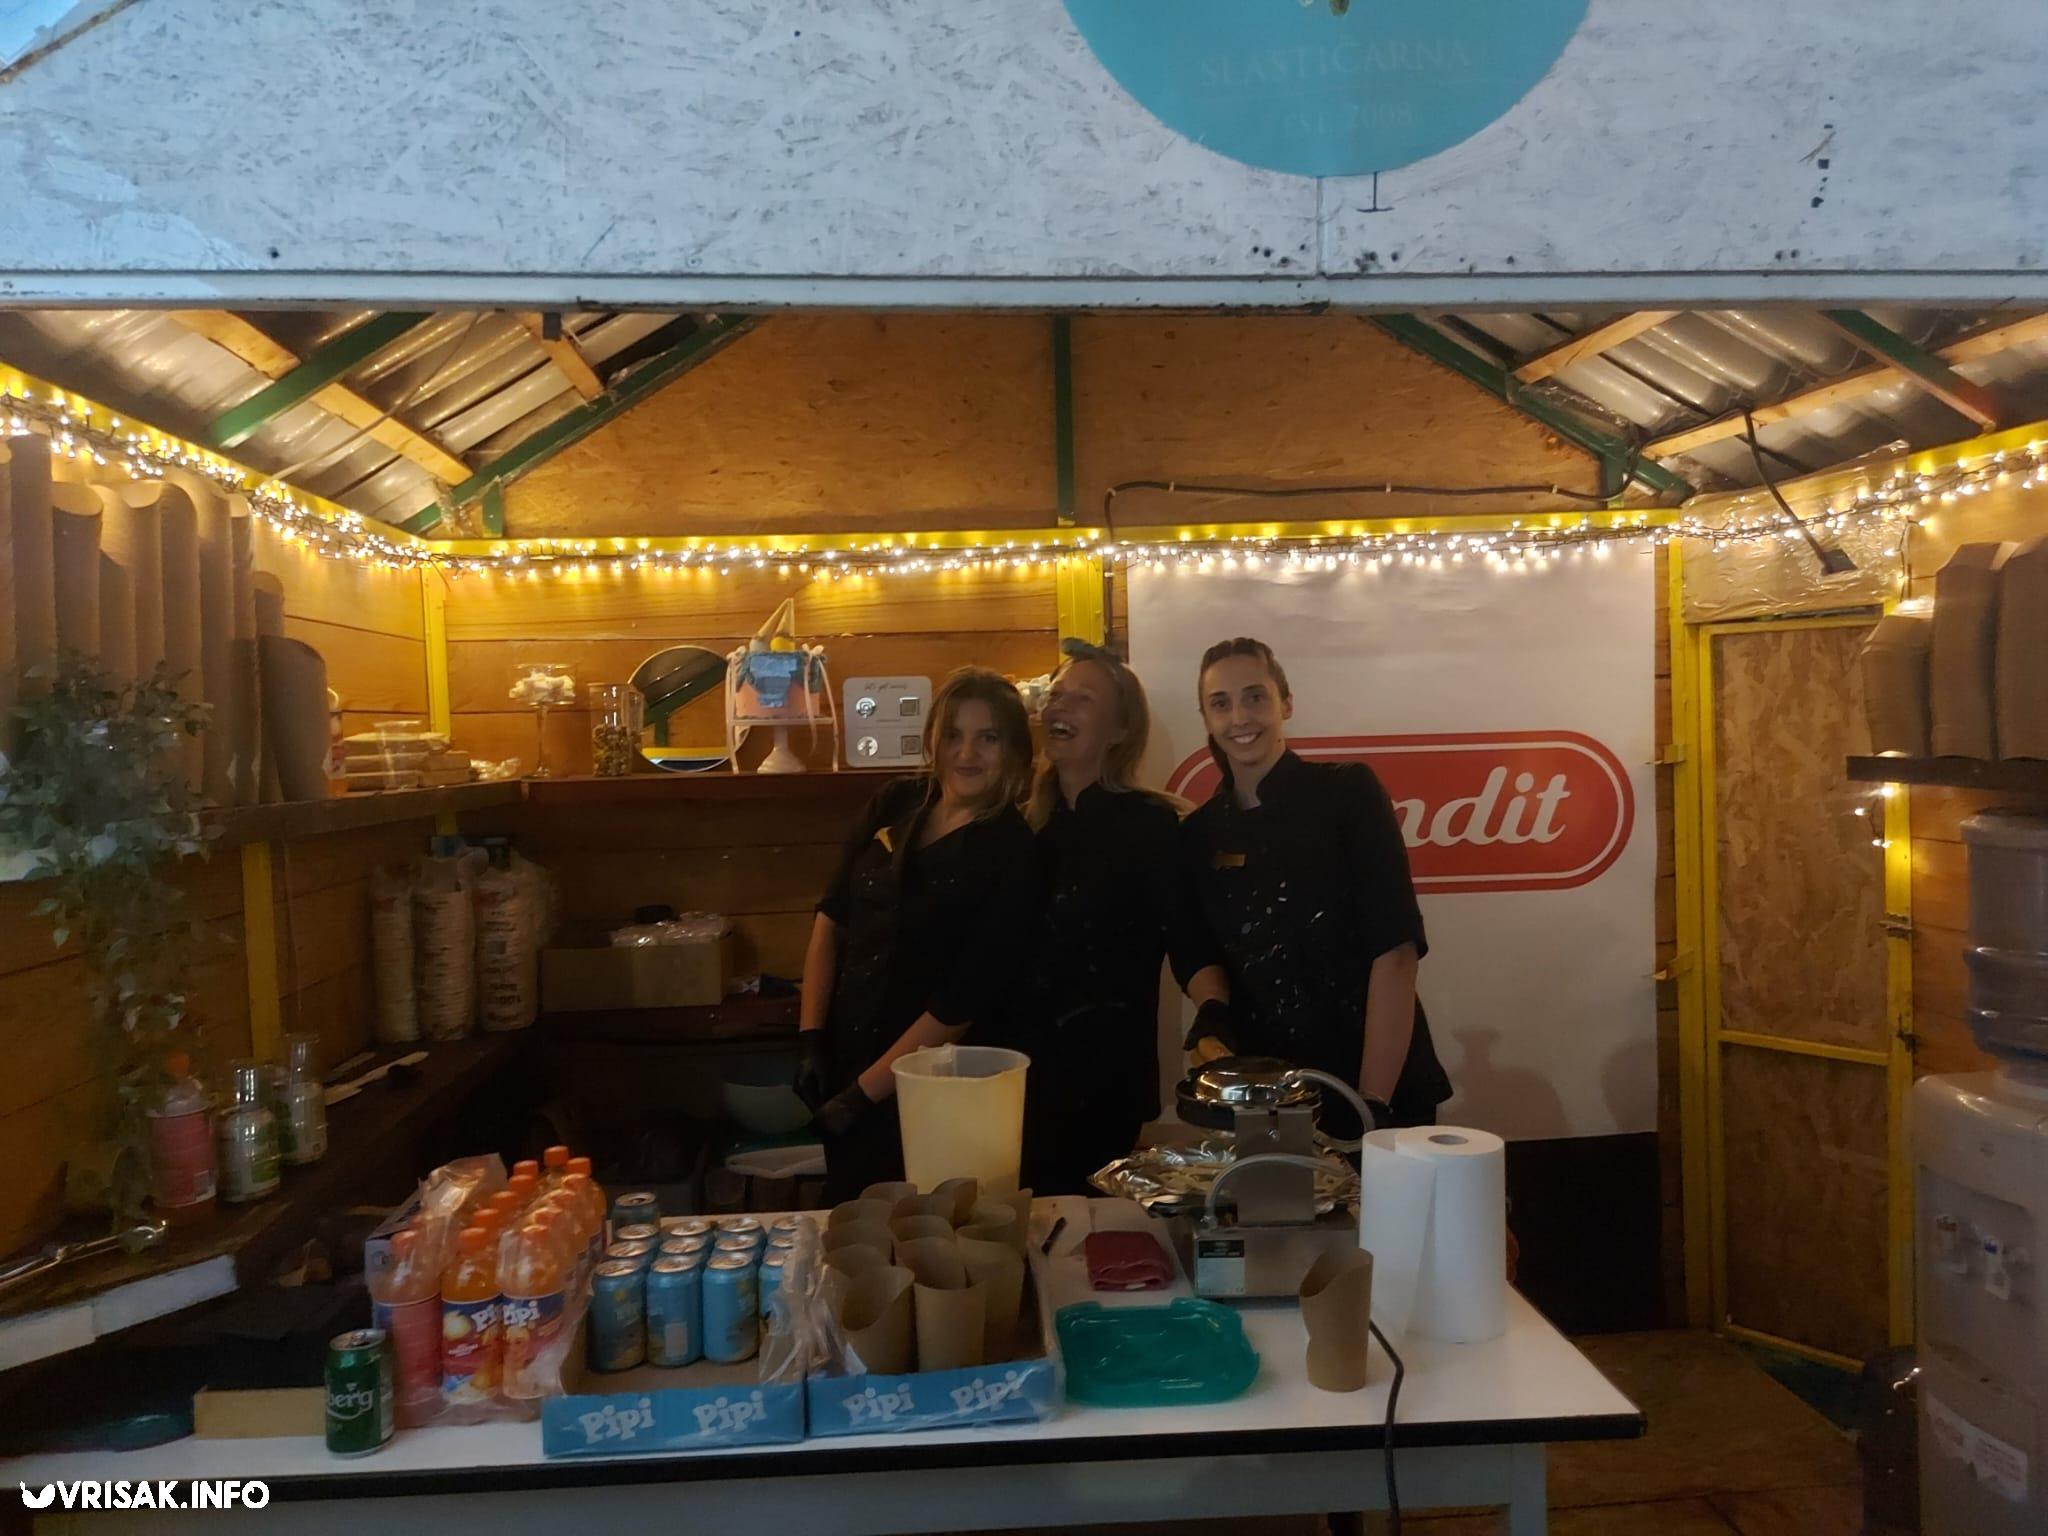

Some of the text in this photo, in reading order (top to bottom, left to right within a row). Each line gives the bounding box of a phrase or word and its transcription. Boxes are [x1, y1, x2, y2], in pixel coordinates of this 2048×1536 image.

[1392, 765, 1572, 848] ndit
[578, 1389, 769, 1445] Pipi Pipi
[841, 1368, 1025, 1425] Pipi Pipi
